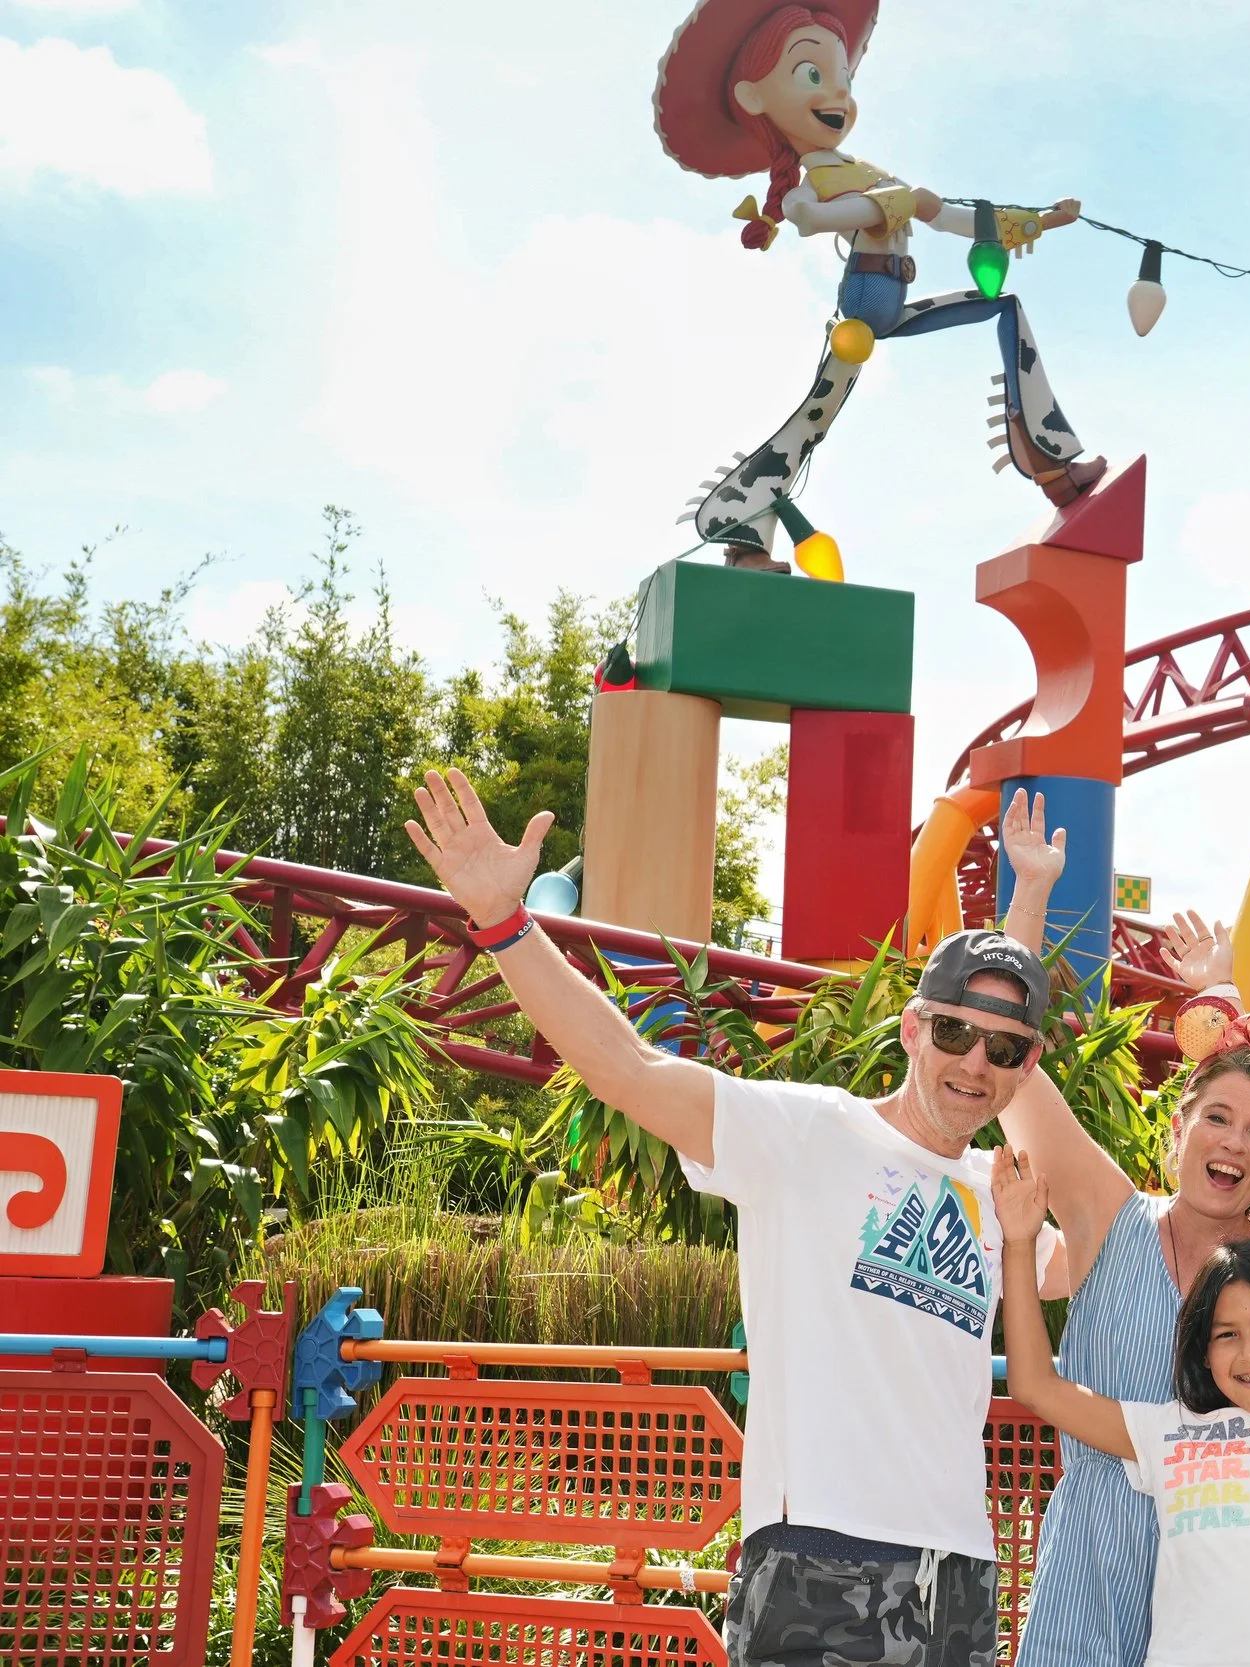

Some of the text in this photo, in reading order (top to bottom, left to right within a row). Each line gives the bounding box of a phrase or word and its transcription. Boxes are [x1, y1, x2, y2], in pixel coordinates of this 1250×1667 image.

[983, 952, 1004, 962] HTC
[873, 1193, 927, 1263] HOOD
[926, 1193, 987, 1298] COAST
[858, 1264, 881, 1275] MOTHER
[898, 1276, 917, 1287] RELAYS
[1163, 1441, 1250, 1466] STAR
[1164, 1458, 1250, 1490] STAR
